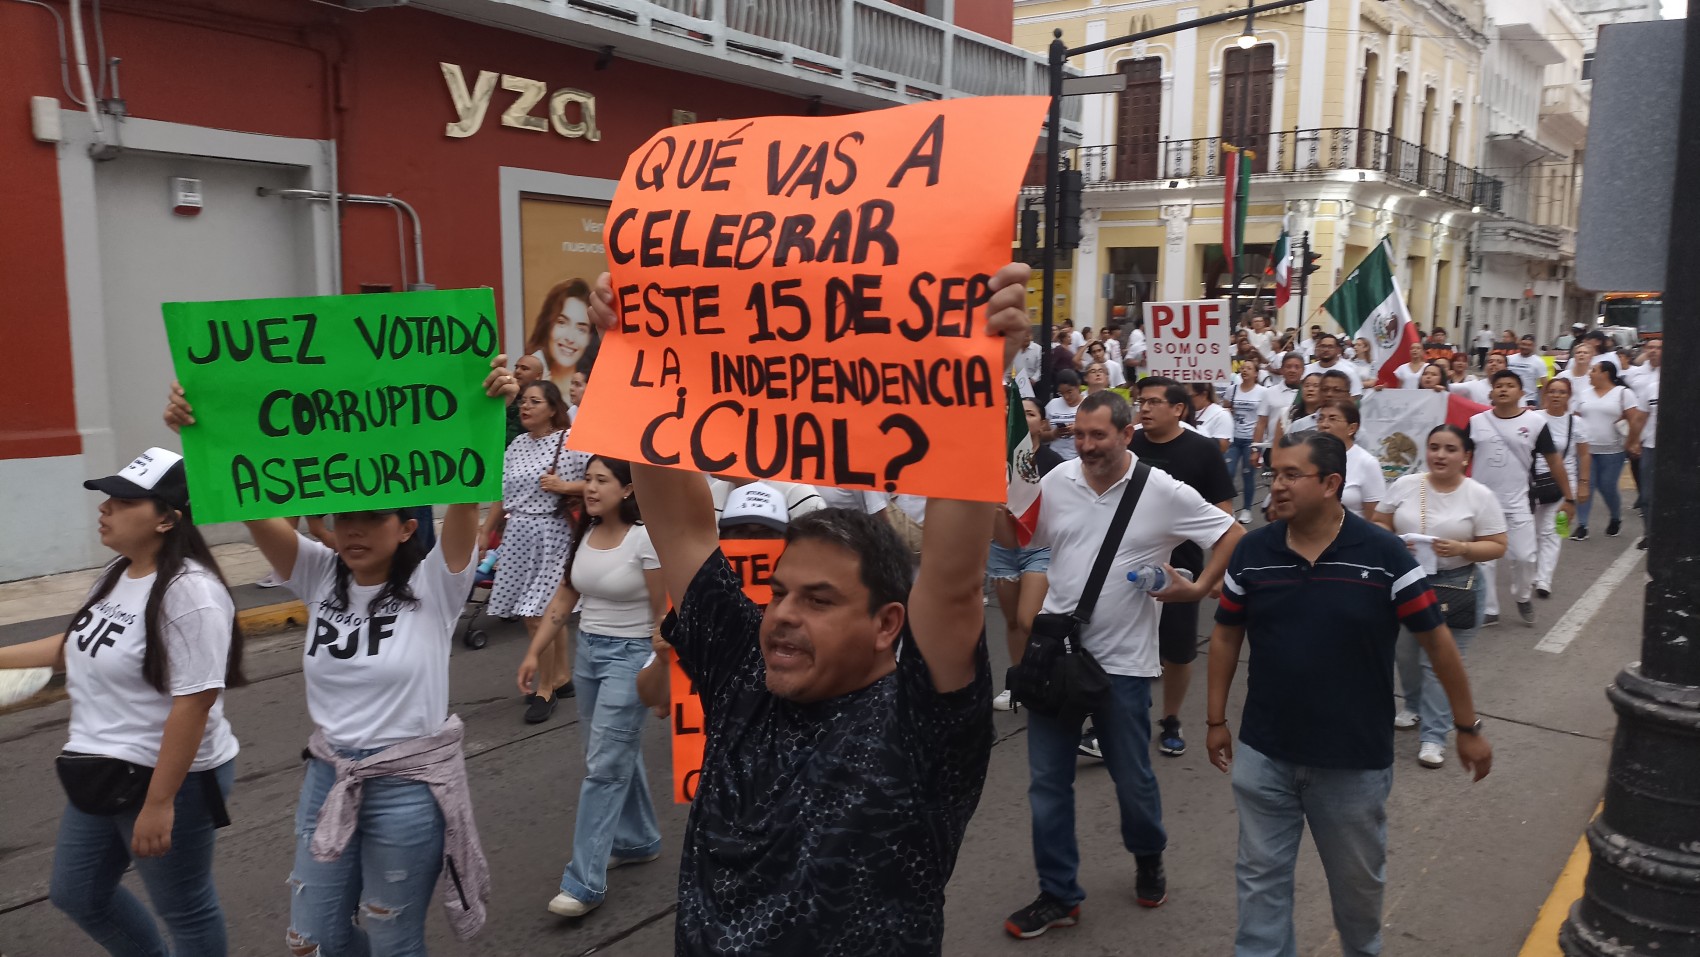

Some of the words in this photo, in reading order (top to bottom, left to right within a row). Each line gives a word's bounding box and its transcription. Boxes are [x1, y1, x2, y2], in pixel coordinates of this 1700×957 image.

[439, 61, 601, 141] yza
[635, 122, 754, 192] QUÉ
[767, 131, 864, 200] VAS
[886, 114, 945, 188] A
[609, 199, 899, 270] CELEBRAR
[618, 282, 725, 336] ESTE
[745, 279, 811, 343] 15
[825, 274, 891, 342] DE
[897, 271, 993, 342] SEP
[1151, 304, 1219, 339] PJF
[188, 313, 326, 365] JUEZ
[354, 313, 497, 360] VOTADO
[1153, 342, 1220, 355] SOMOS
[1173, 356, 1198, 368] TU
[630, 347, 681, 388] LA
[711, 350, 995, 408] INDEPENDENCIA
[1151, 369, 1226, 381] DEFENSA
[258, 383, 457, 437] CORRUPTO
[231, 447, 486, 507] ASEGURADO
[72, 609, 126, 658] PJF
[307, 614, 398, 660] PJF
